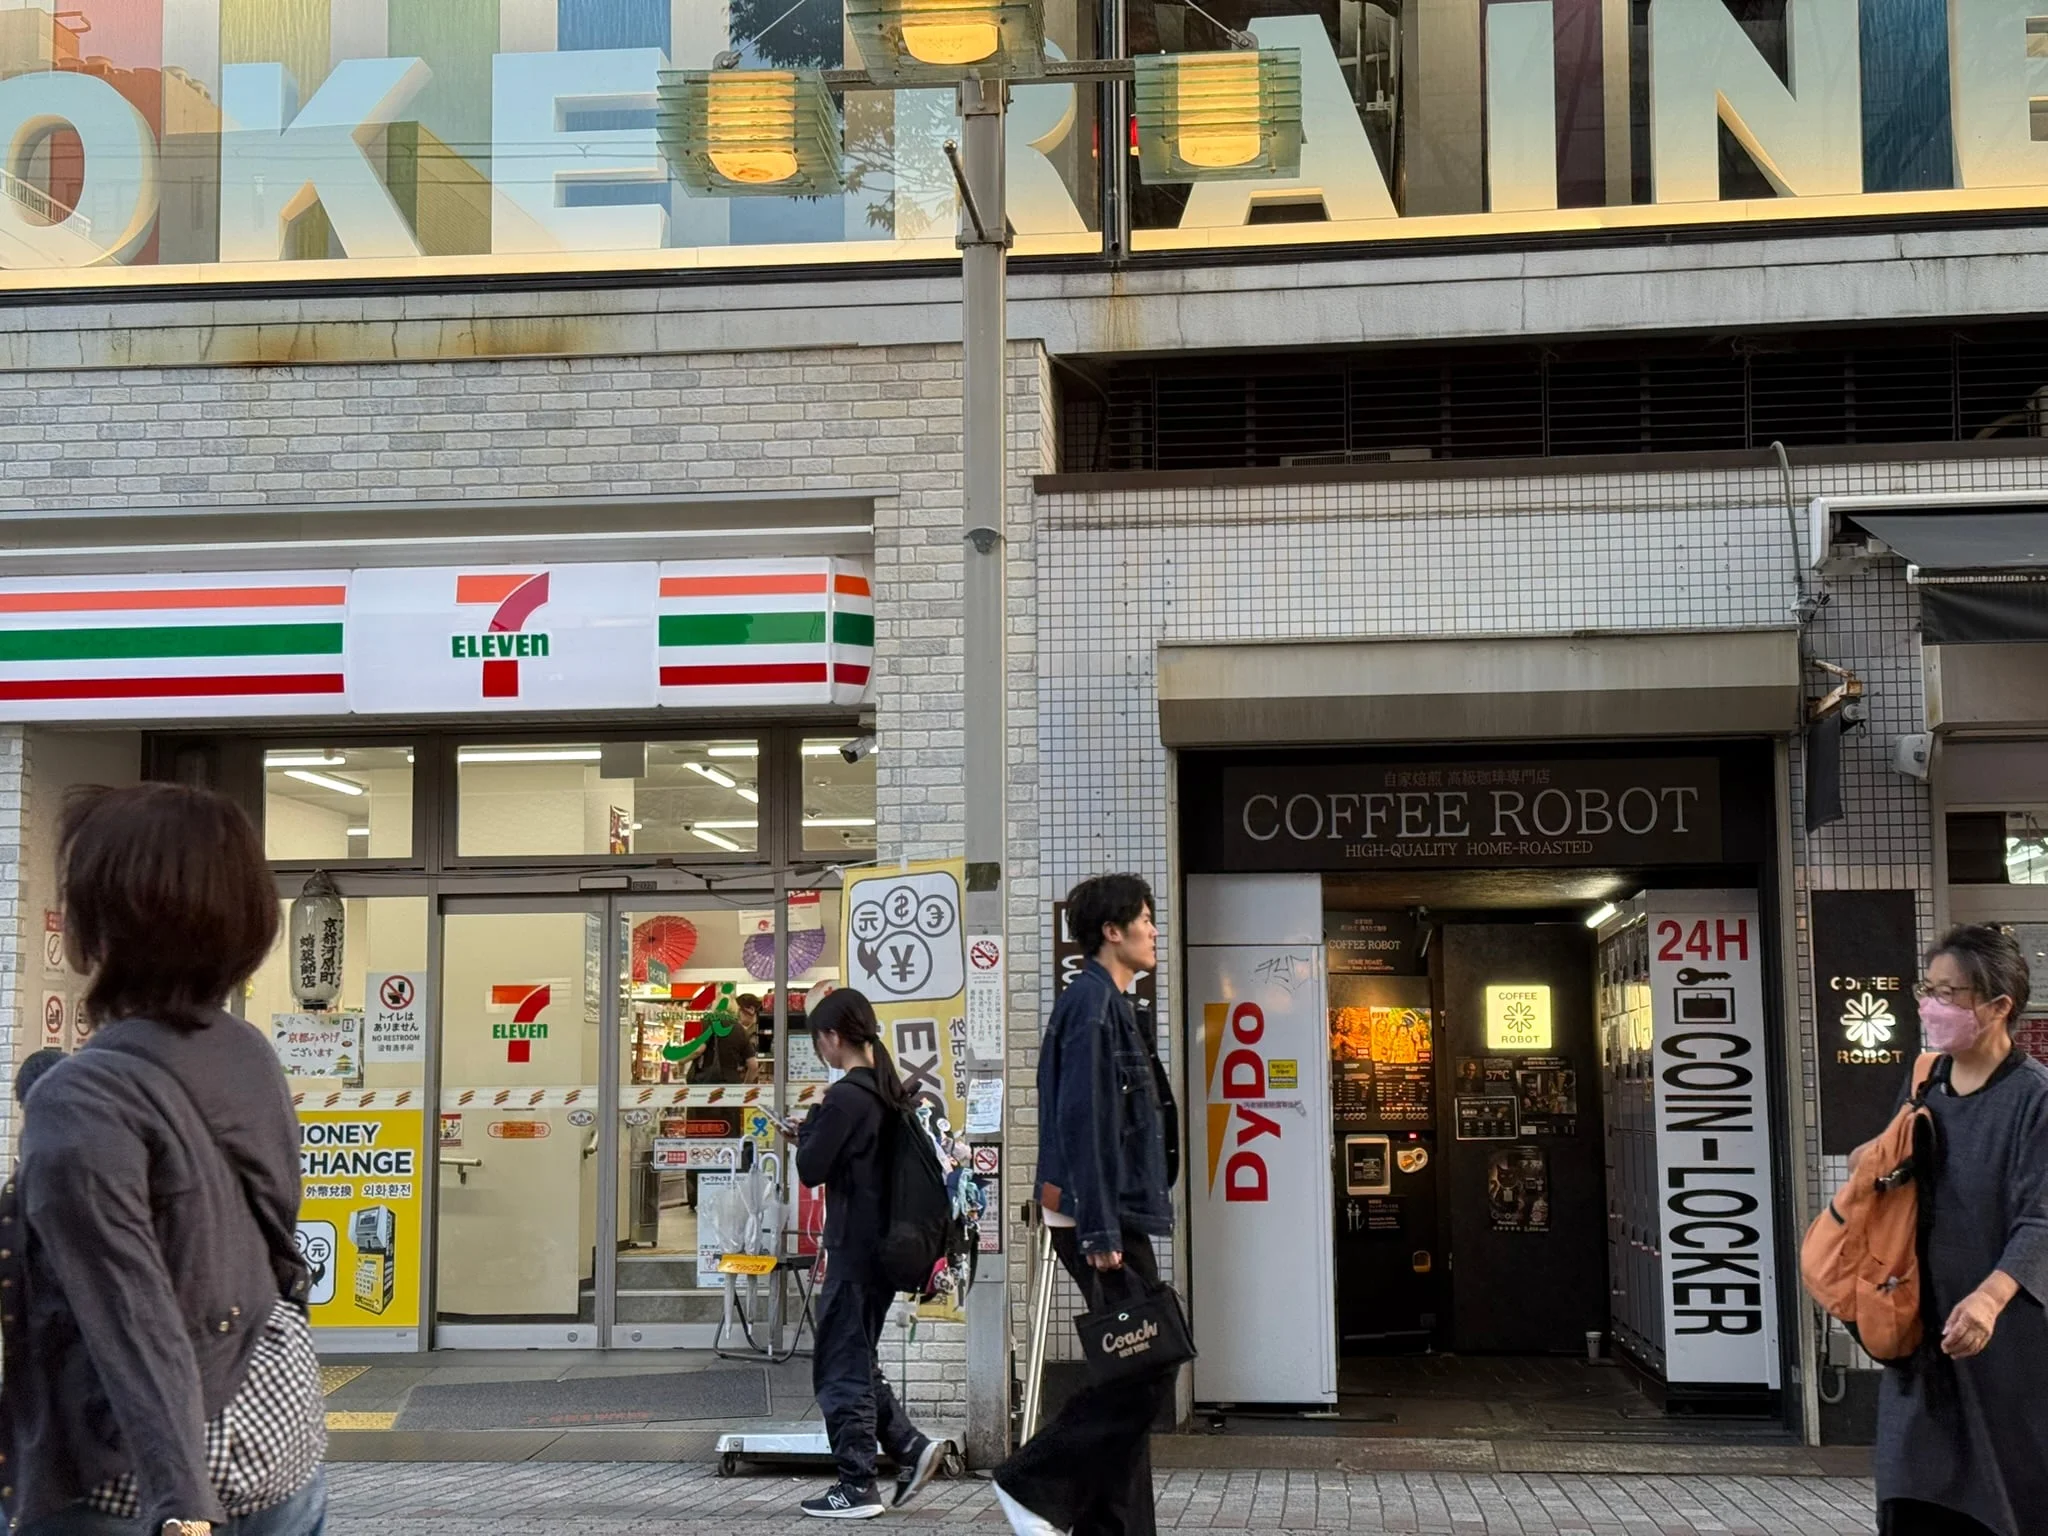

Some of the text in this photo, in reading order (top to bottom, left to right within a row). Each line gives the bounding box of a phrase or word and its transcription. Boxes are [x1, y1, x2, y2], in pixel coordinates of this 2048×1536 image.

[1243, 787, 1698, 841] COFFEE ROBOT
[1345, 840, 1593, 859] HIGH-QUALITY HOME-ROASTED
[1328, 939, 1401, 950] COFFEE ROBOT
[1657, 919, 1748, 961] 24H
[319, 917, 338, 985] 京都河原町
[1830, 976, 1900, 991] COFFEE
[1498, 991, 1538, 1001] COFFEE
[379, 1012, 414, 1022] トイレは
[373, 1022, 419, 1032] ありません
[287, 1031, 341, 1043] 京都みやげ
[383, 1034, 420, 1042] RESTROOM
[1501, 1035, 1540, 1044] ROBOT
[290, 1047, 334, 1058] ございます
[1836, 1049, 1905, 1064] ROBOT
[1223, 1002, 1281, 1202] DyDo
[362, 1183, 412, 1198] 외화환전
[1660, 1031, 1762, 1336] COIN-LOCKER
[1102, 1319, 1158, 1353] Coach
